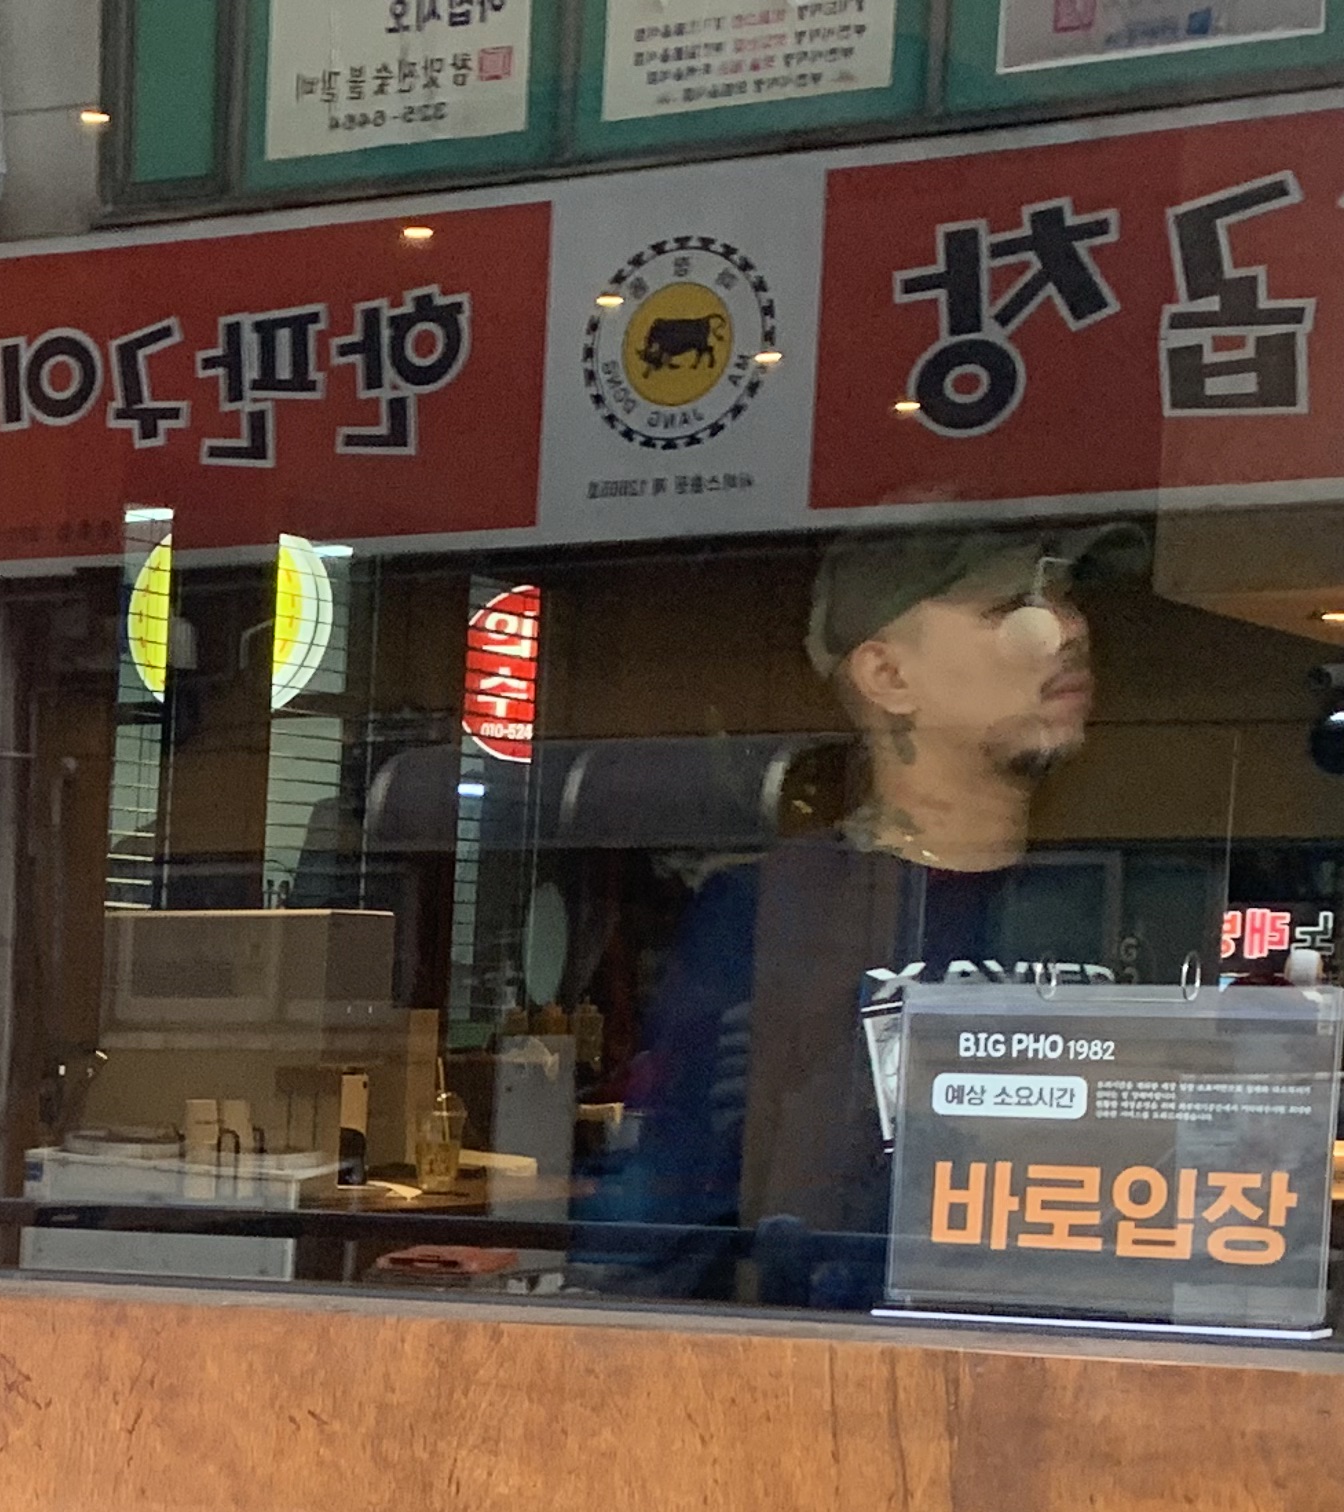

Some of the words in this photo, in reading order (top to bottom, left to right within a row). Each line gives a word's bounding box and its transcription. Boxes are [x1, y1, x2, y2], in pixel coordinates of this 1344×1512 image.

[959, 1032, 1007, 1058] BIG
[1012, 1033, 1064, 1060] PHO
[1066, 1039, 1116, 1061] 1982
[944, 1083, 986, 1106] 예상
[993, 1085, 1076, 1109] 소요시간
[930, 1160, 1298, 1266] 바로입장
